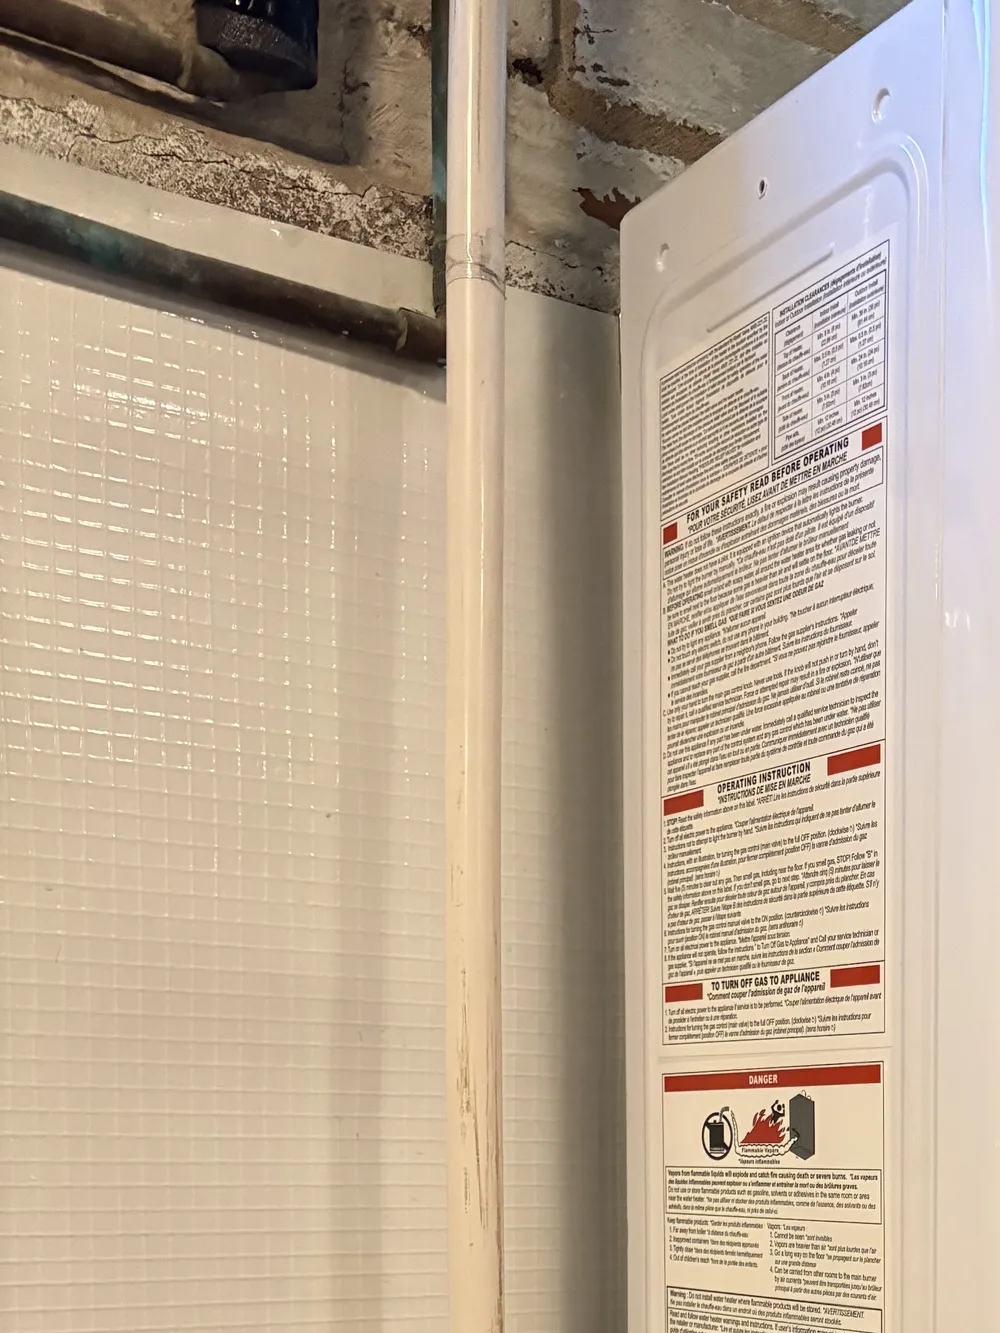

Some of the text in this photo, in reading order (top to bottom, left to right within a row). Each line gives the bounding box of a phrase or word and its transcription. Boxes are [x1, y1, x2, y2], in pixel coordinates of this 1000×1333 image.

[687, 436, 849, 523] FOR YOUR SAFETY READ BEFORE OPERATING
[717, 761, 810, 795] OPERATING INSTRUCTION
[712, 971, 820, 991] TO TURN OFF GAS TO APPLIANCE
[749, 1074, 778, 1085] DANGER
